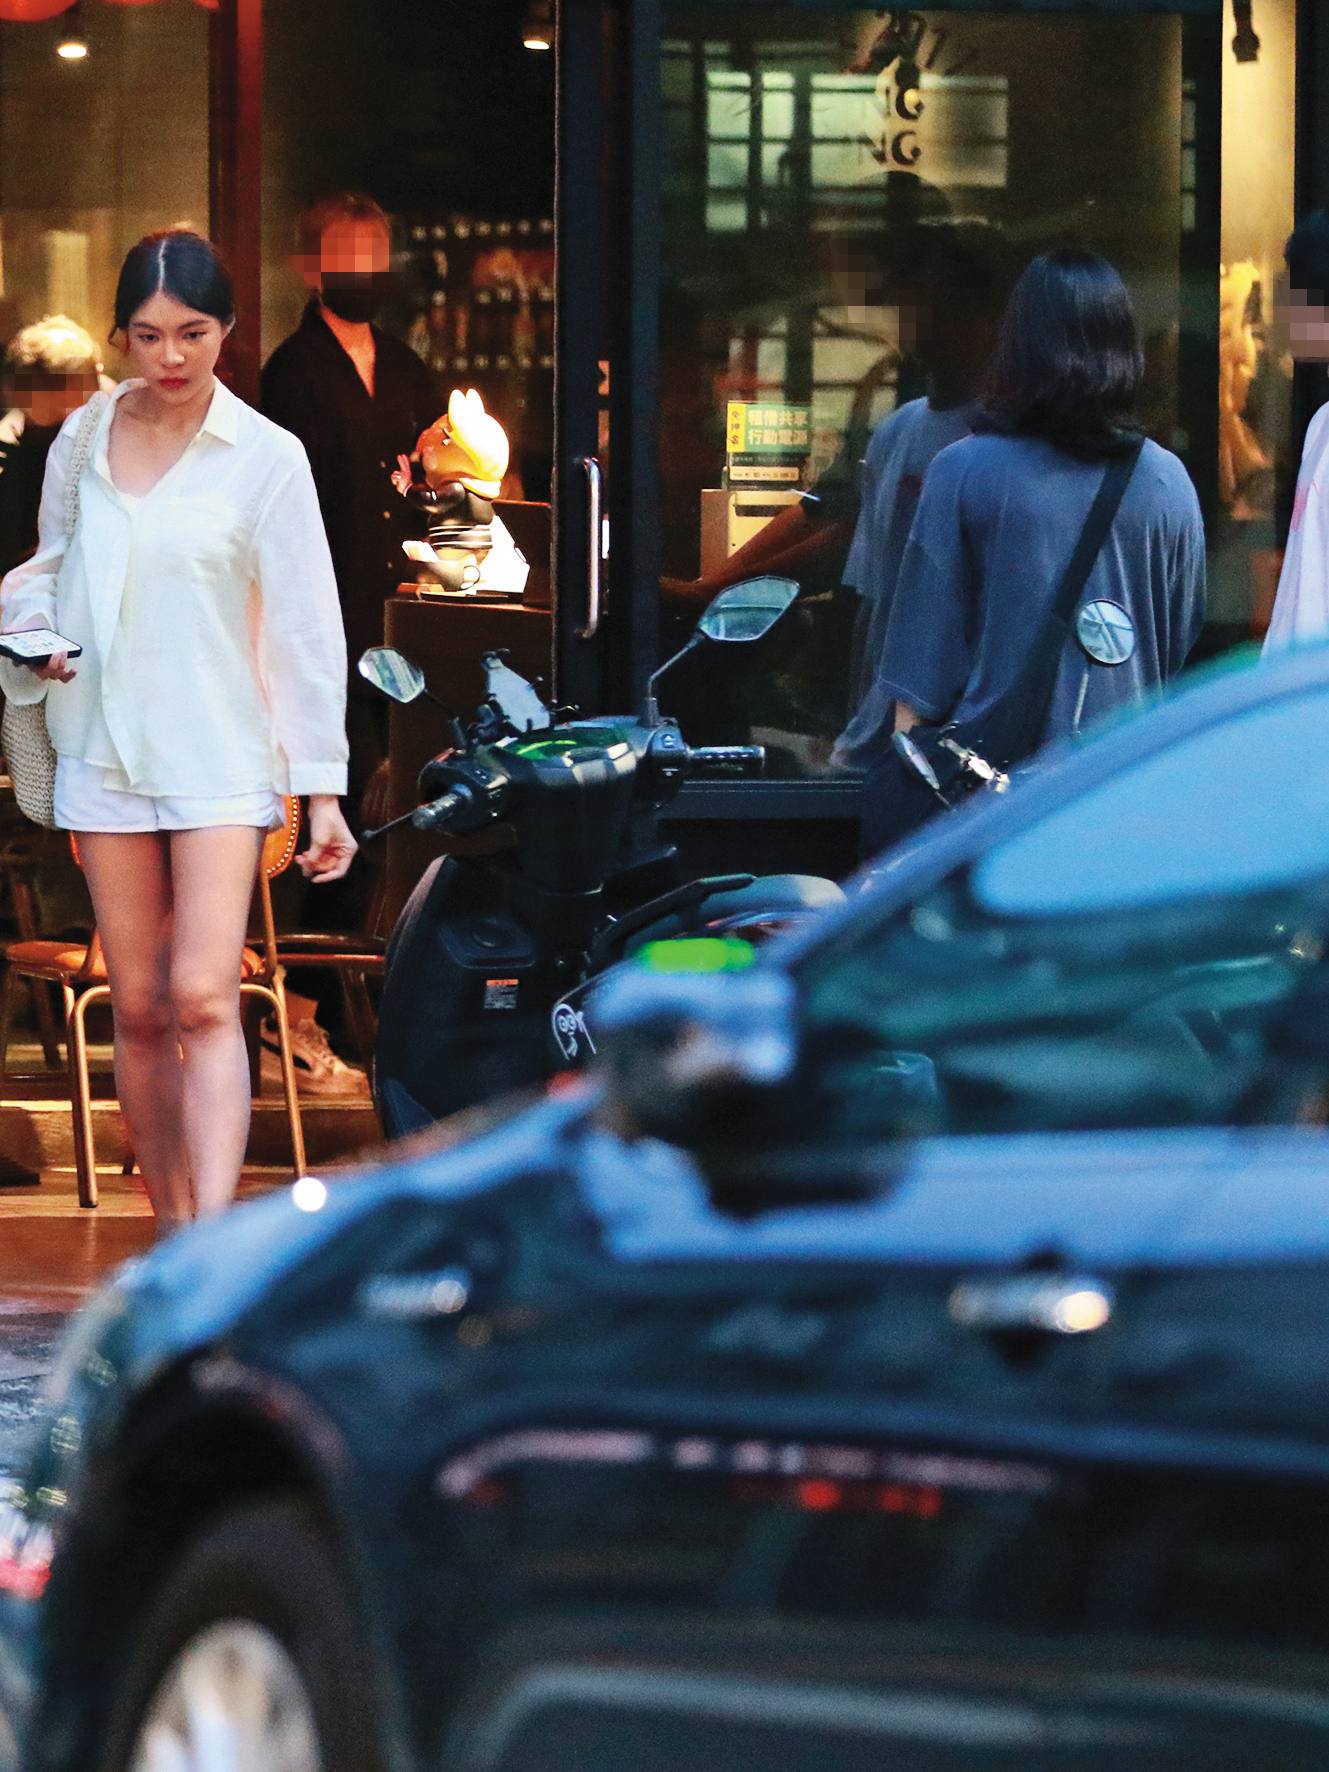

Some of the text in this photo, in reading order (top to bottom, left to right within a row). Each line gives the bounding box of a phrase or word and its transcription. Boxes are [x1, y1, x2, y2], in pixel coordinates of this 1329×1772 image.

[748, 410, 808, 426] 租借共享
[748, 428, 808, 446] 行動電源
